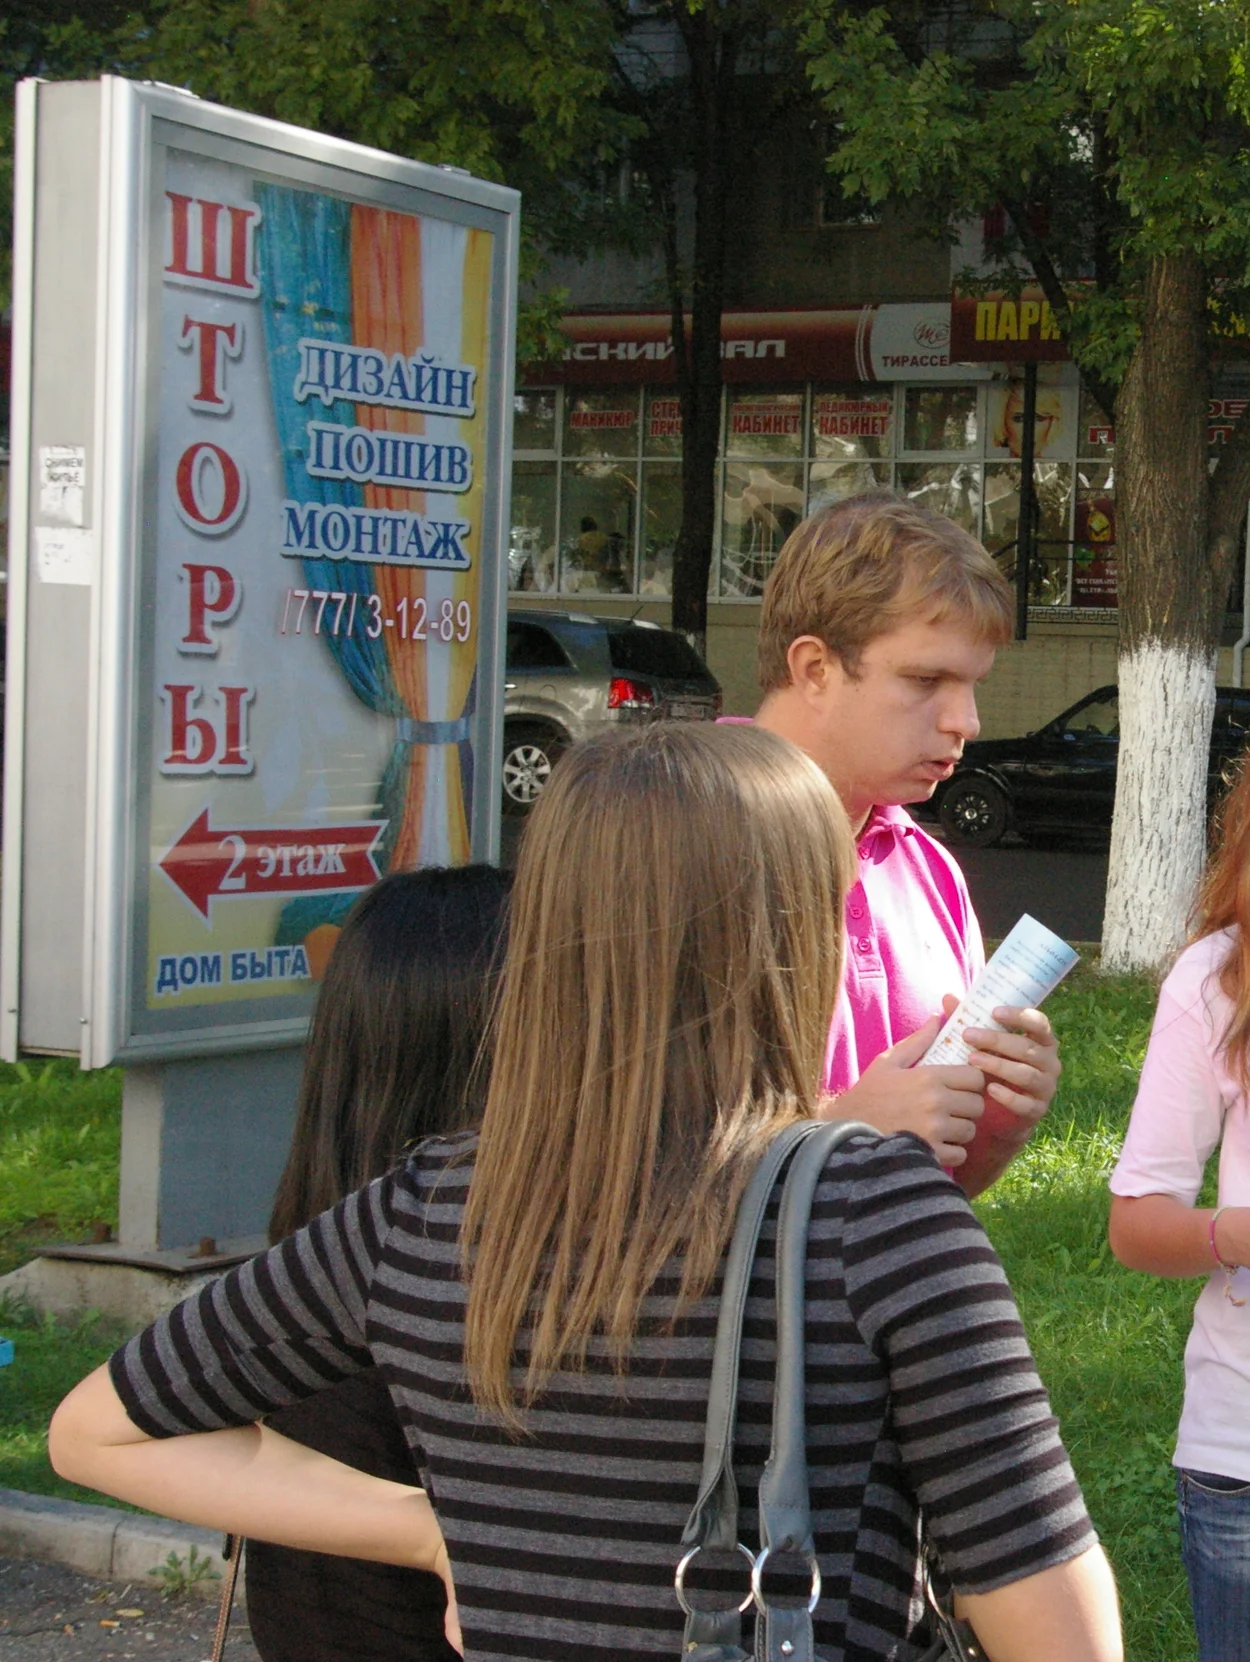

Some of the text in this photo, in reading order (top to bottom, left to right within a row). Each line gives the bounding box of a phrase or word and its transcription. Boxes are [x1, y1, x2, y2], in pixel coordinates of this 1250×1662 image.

[975, 301, 1061, 340] ПАРИ
[720, 339, 786, 358] АЛ
[882, 355, 950, 367] ТИРАССЕ
[301, 345, 474, 410] ДИЗАЙН
[571, 411, 635, 428] МАНИКЮР
[733, 415, 800, 434] КАБИНЕТ
[819, 416, 889, 435] КАБИНЕТ
[164, 191, 255, 766] ШТОРЫ
[308, 426, 469, 485] ПОШИВ
[284, 507, 466, 562] МОНТАЖ
[367, 595, 472, 643] 3-12-89
[218, 834, 347, 890] 2 этаж
[157, 945, 310, 993] ДОМ БЫТА
